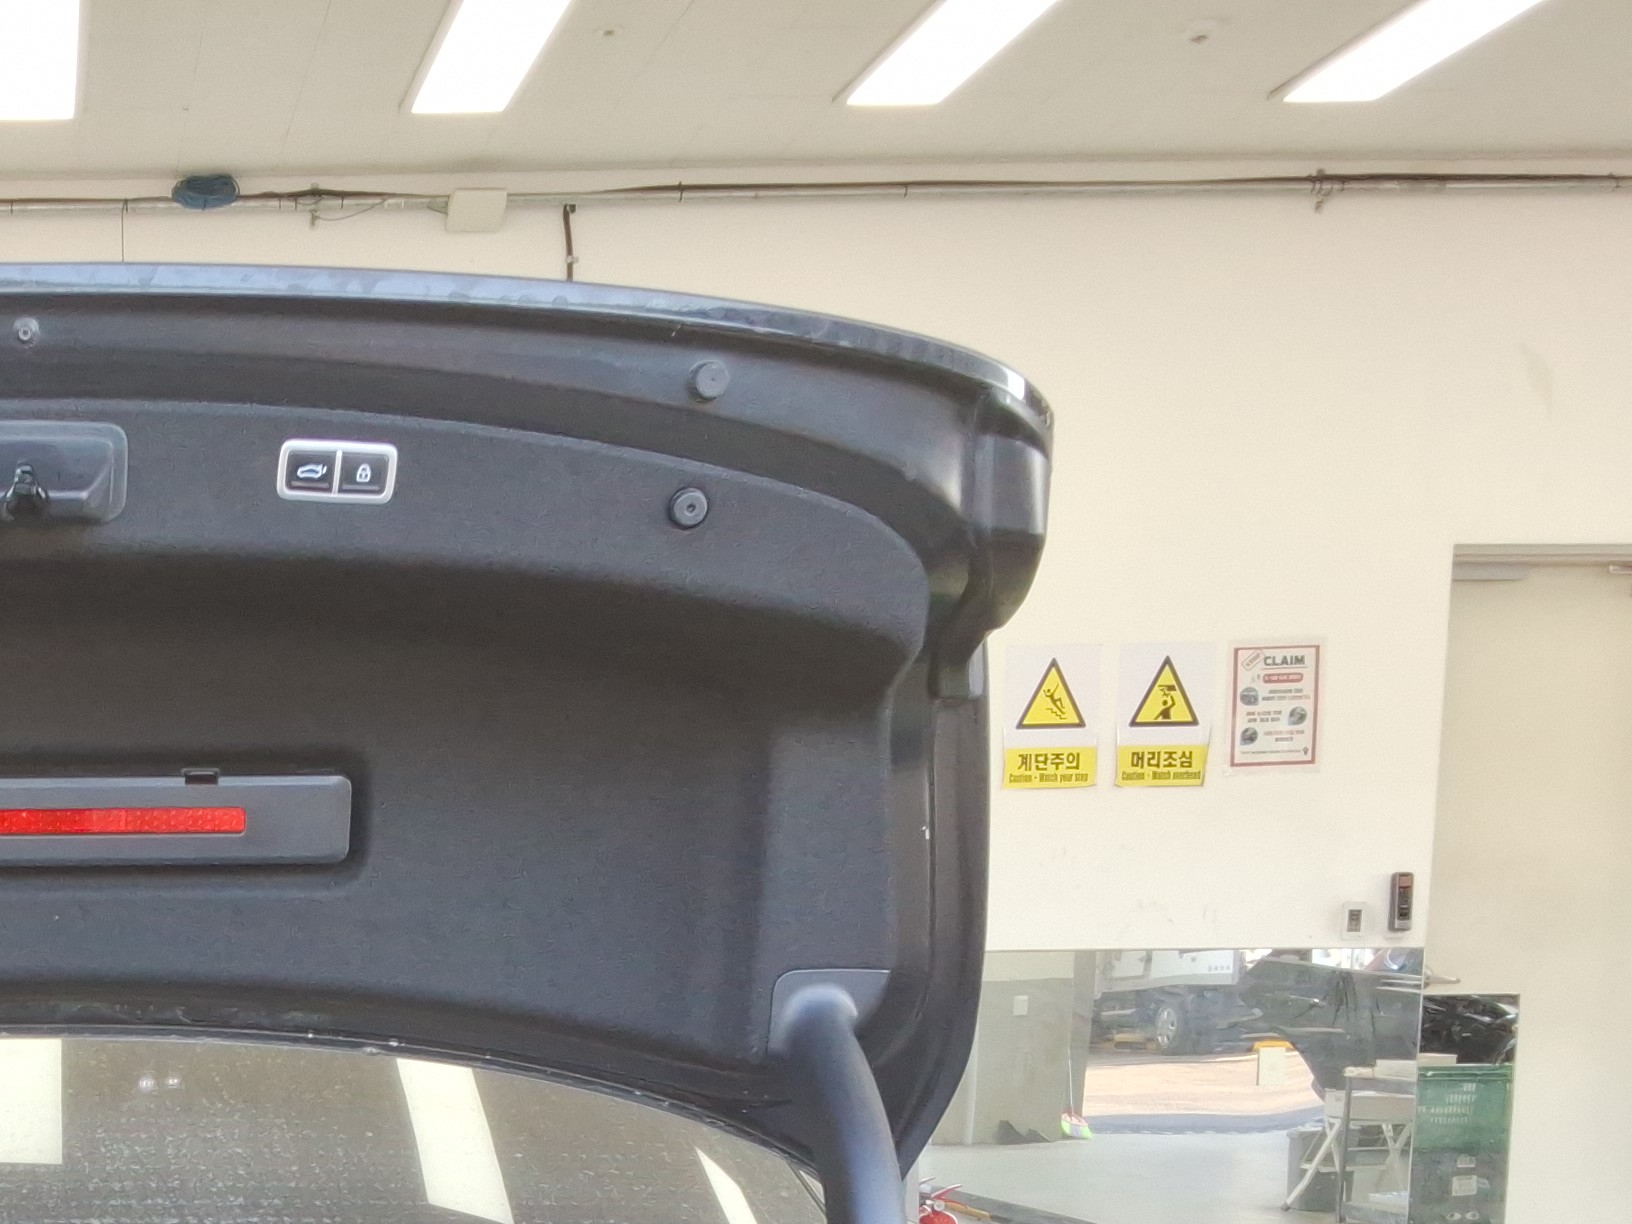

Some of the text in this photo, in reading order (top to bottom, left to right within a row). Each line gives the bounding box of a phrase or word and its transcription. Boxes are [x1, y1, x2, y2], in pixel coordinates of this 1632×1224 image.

[1263, 654, 1306, 667] CLAIM
[1017, 752, 1081, 771] 계단주의
[1130, 750, 1193, 769] 머리조심
